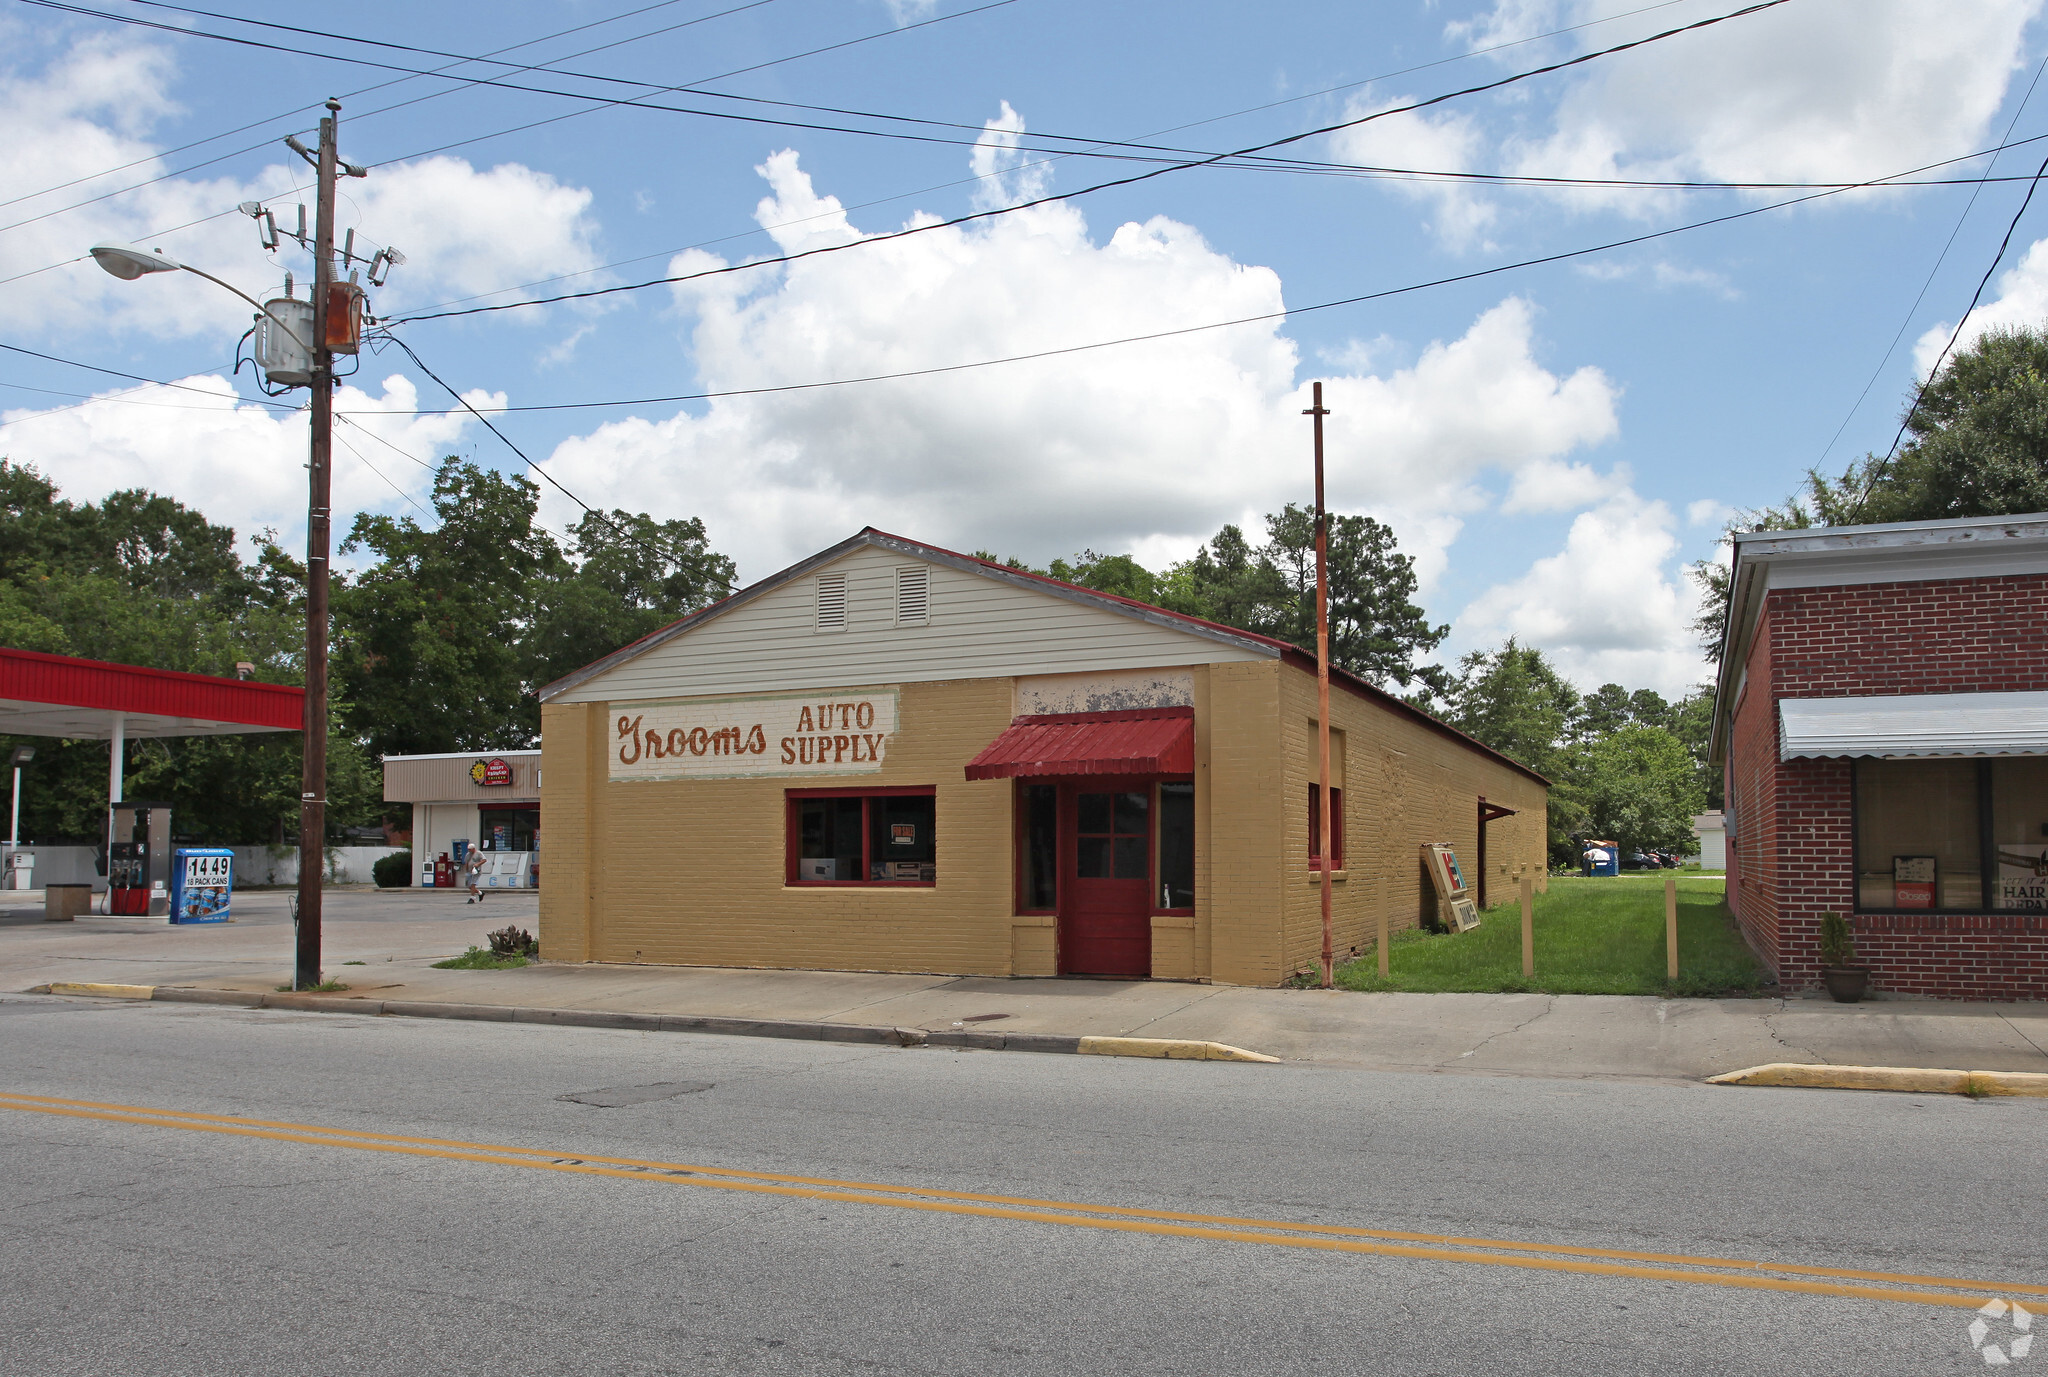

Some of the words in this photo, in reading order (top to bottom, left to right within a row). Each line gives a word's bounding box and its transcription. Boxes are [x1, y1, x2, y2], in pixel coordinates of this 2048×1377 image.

[795, 701, 874, 733] AUTO
[618, 714, 767, 765] Grooms
[781, 733, 884, 765] SUPPLY
[211, 877, 228, 885] CANS
[2003, 886, 2046, 898] HAIR
[1898, 890, 1931, 901] Closed
